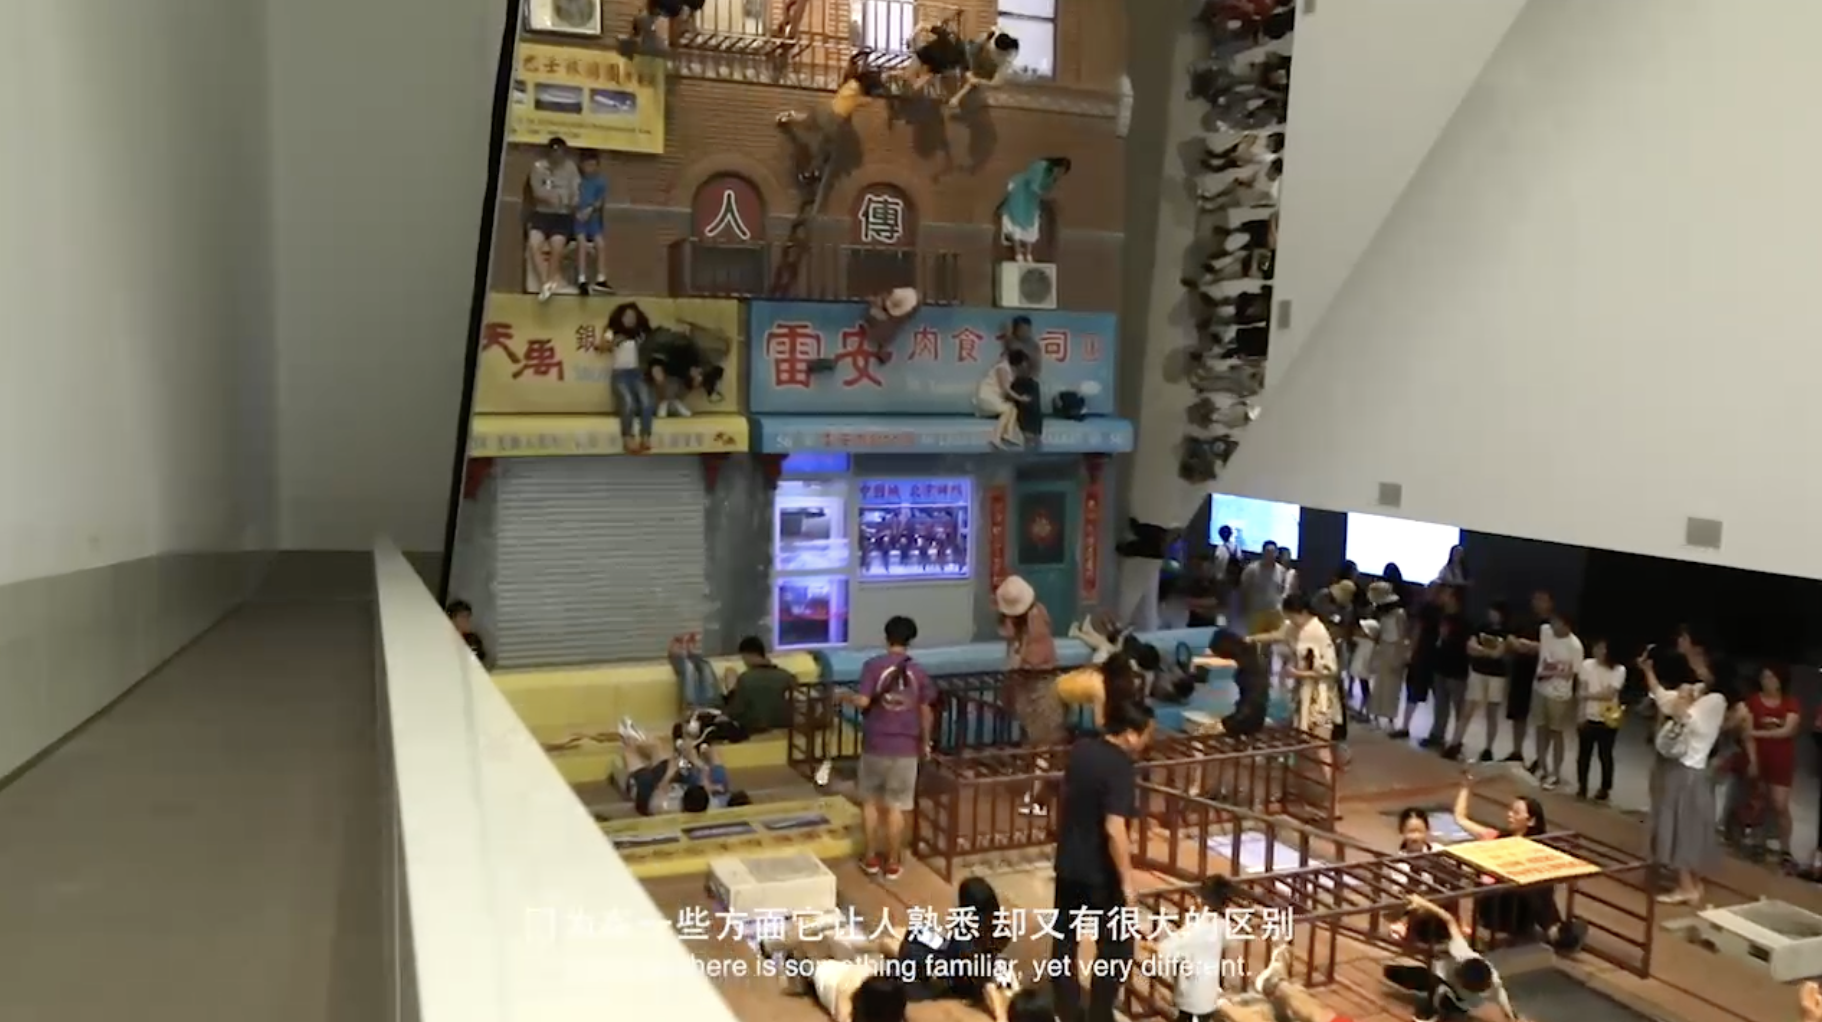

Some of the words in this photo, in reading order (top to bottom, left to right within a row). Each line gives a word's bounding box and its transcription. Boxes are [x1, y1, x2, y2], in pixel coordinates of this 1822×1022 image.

[705, 189, 750, 240] 人
[858, 194, 904, 243] 傳
[765, 321, 893, 389] 雷安
